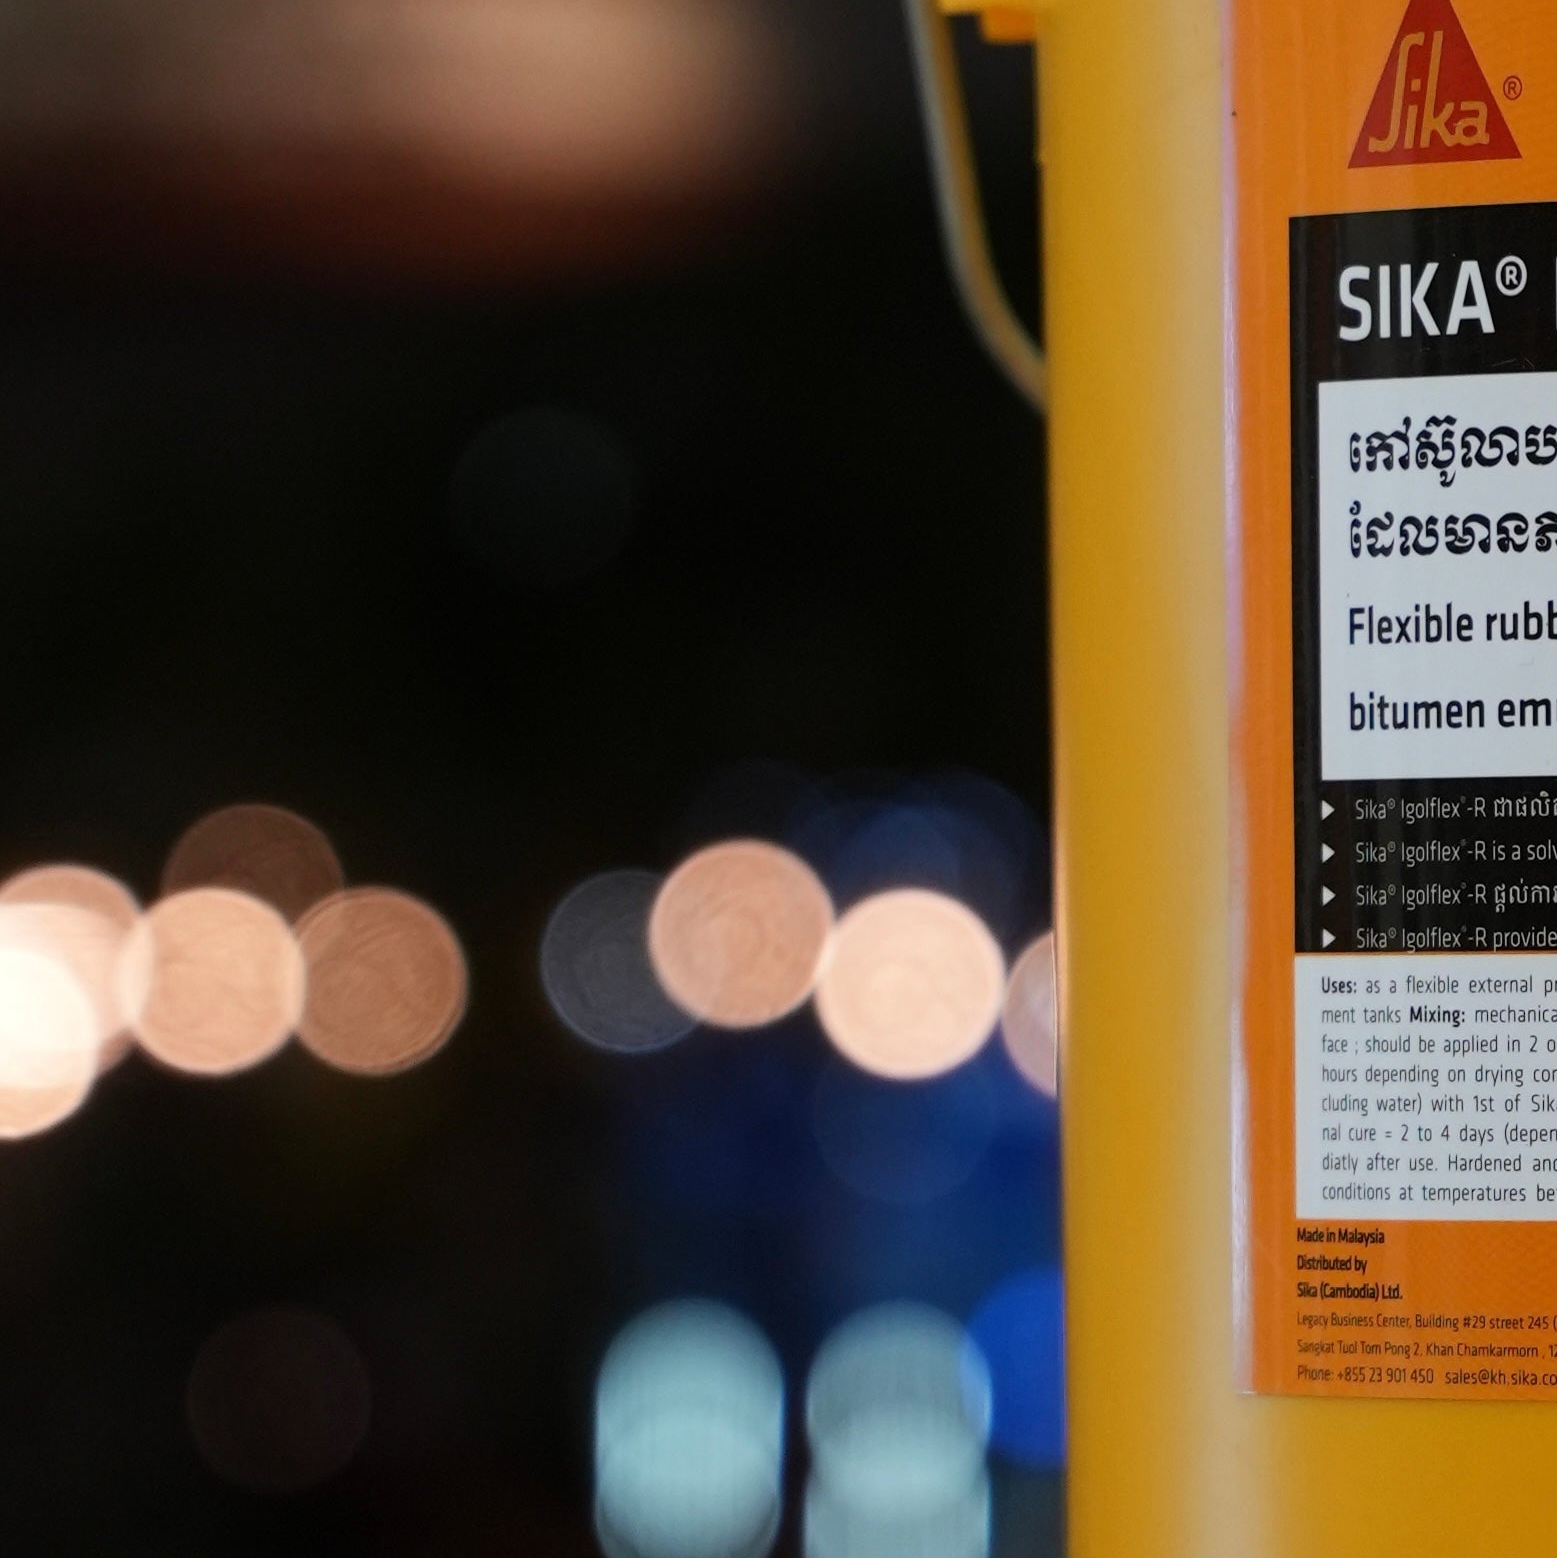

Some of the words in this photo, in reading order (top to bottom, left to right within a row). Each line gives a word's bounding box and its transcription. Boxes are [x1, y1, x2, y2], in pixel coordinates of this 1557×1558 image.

[1338, 254, 1528, 342] SIKA®
[1349, 601, 1474, 646] Flexible
[1349, 690, 1485, 732] bitumen
[1355, 797, 1396, 820] Sika®
[1355, 841, 1396, 864] Sika®
[1492, 839, 1506, 861] is
[1511, 844, 1521, 861] a
[1356, 882, 1397, 906] Sika®
[1356, 926, 1397, 949] Sika®
[1321, 976, 1357, 995] Uses:
[1365, 979, 1381, 994] as
[1389, 979, 1397, 994] a
[1405, 974, 1459, 994] flexible
[1468, 974, 1533, 994] external
[1322, 1182, 1391, 1201] conditions
[1399, 1184, 1414, 1201] at
[1421, 1184, 1527, 1206] temperatures
[1296, 1226, 1325, 1243] Made
[1325, 1227, 1337, 1243] in
[1337, 1227, 1385, 1248] Malaysia
[1296, 1254, 1353, 1272] Distributed
[1353, 1255, 1368, 1276] by
[1296, 1281, 1318, 1298] Sika
[1319, 1281, 1380, 1302] (Cambodia)
[1381, 1283, 1404, 1300] Ltd.
[1296, 1311, 1329, 1330] Legacy
[1330, 1311, 1374, 1328] Business
[1414, 1313, 1460, 1333] Building
[1462, 1314, 1486, 1330] #29
[1489, 1317, 1525, 1330] street
[1527, 1315, 1550, 1330] 245
[1297, 1338, 1335, 1357] Sangkat
[1336, 1339, 1358, 1355] Tuol
[1359, 1340, 1382, 1356] Tom
[1383, 1340, 1411, 1360] Pong
[1425, 1342, 1454, 1357] Khan
[1297, 1364, 1334, 1382] Phone:
[1337, 1366, 1366, 1383] +855
[1368, 1366, 1383, 1383] 23
[1385, 1367, 1407, 1384] 901
[1409, 1367, 1434, 1385] 450
